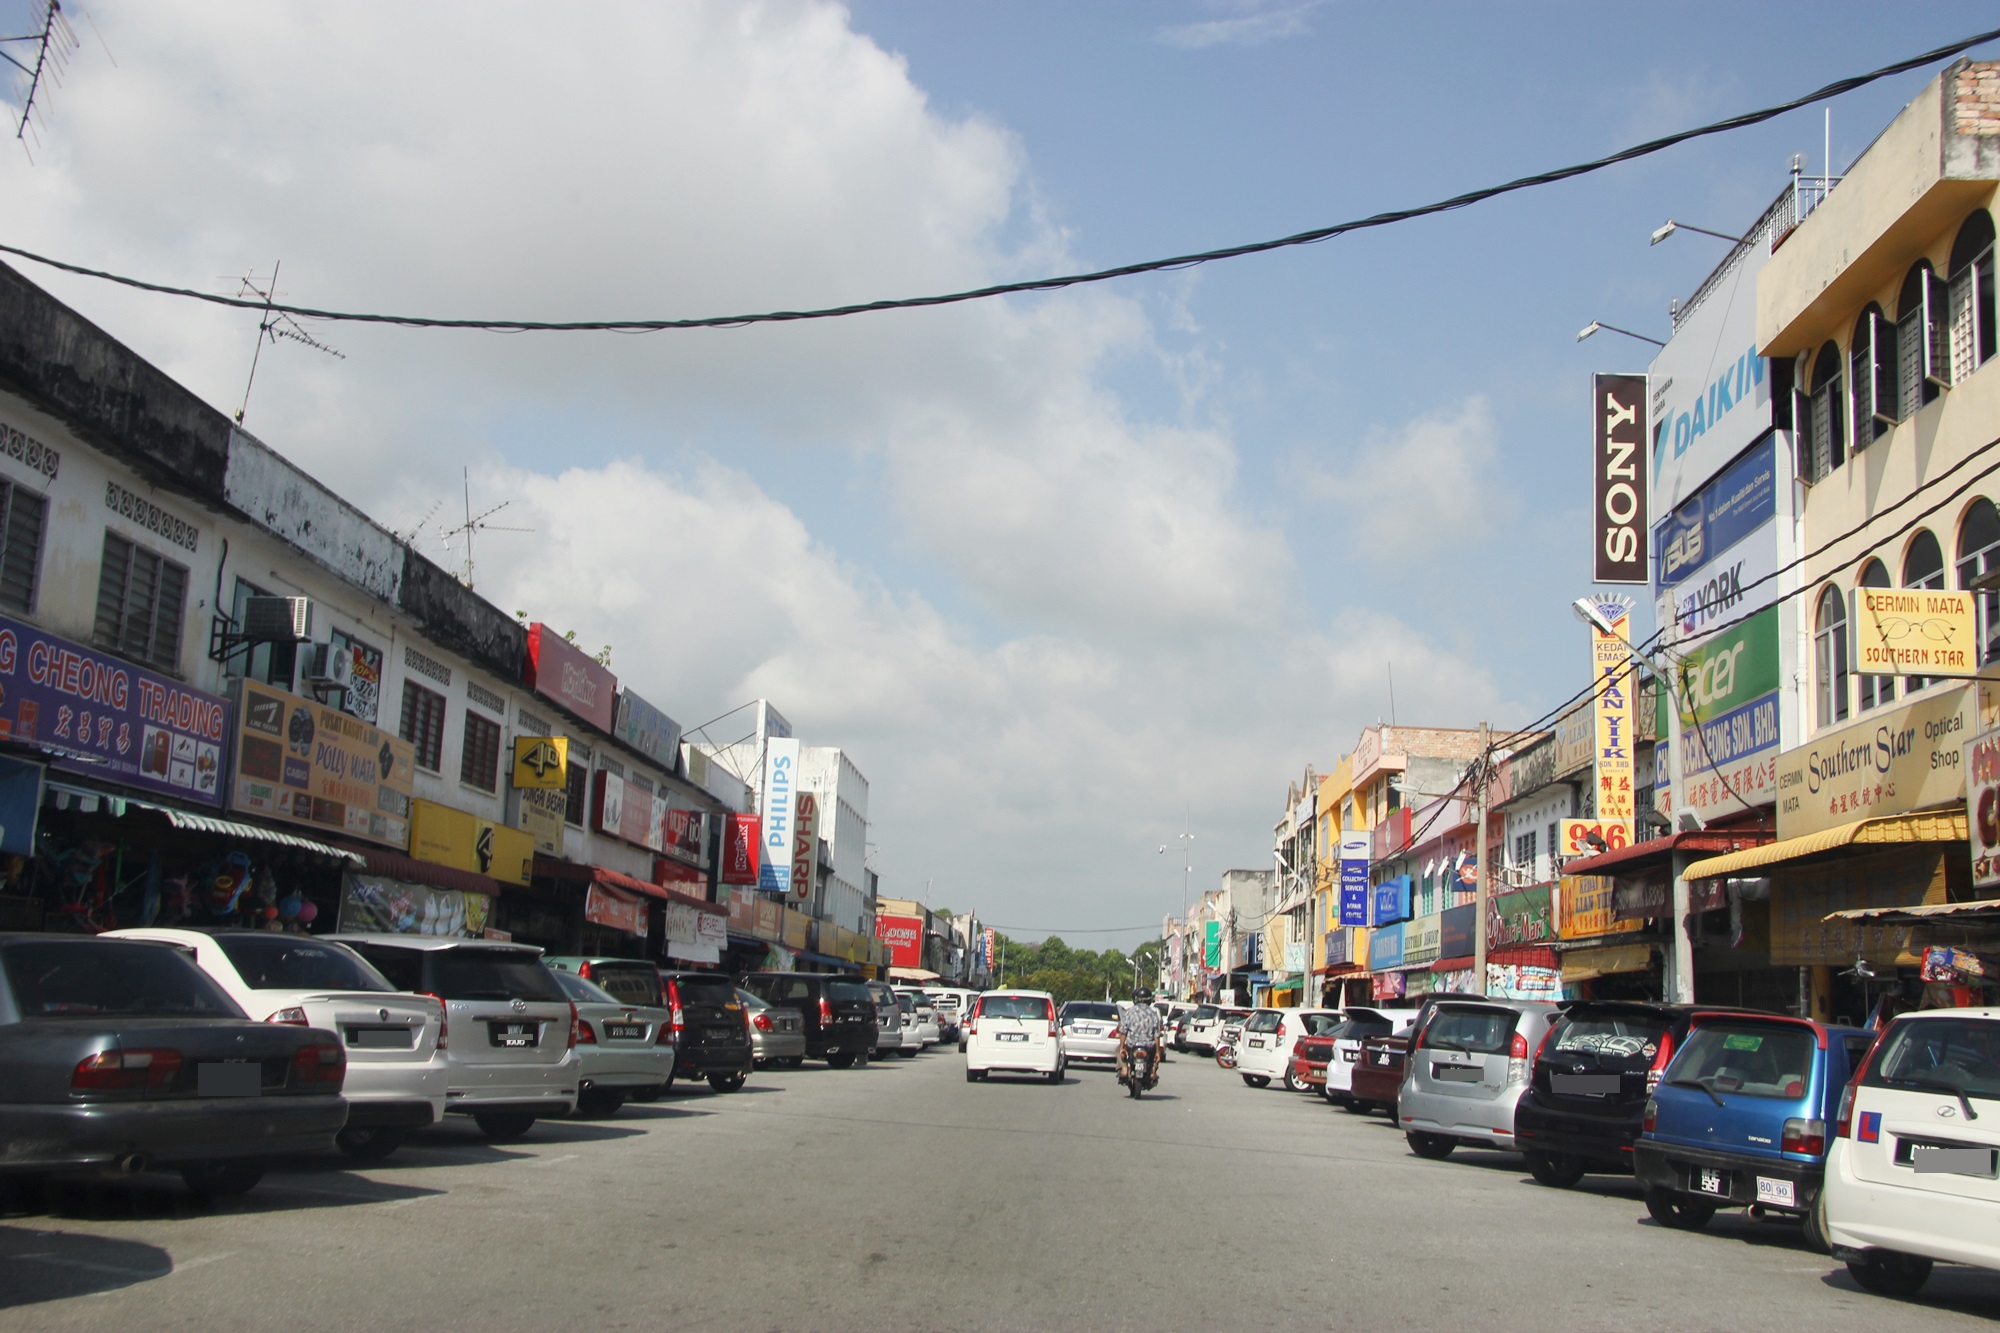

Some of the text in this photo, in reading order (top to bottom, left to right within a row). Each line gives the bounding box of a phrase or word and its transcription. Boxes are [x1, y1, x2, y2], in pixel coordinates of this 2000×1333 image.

[1674, 343, 1765, 460] DAIKIN
[1605, 392, 1638, 563] SONY
[1754, 469, 1771, 488] Servis
[1661, 521, 1702, 581] ASUS
[1697, 560, 1744, 626] YORK
[1866, 595, 1965, 615] CERMIN MATA
[1596, 643, 1627, 652] KEDAI
[1597, 653, 1626, 661] EMAS
[1866, 648, 1965, 667] SOUTHERN STAR
[28, 640, 129, 711] CHEONG
[138, 677, 223, 741] TRADING
[1602, 666, 1625, 709] LIAN
[1682, 640, 1744, 714] acer
[319, 709, 342, 733] PUSAT
[342, 718, 363, 741] KASUT
[1702, 720, 1731, 767] LEONG
[1732, 711, 1754, 756] SDN.
[1754, 701, 1777, 747] BHD.
[1924, 711, 1963, 742] Optical
[286, 766, 308, 781] CASIO
[315, 742, 349, 780] POLLY
[1808, 725, 1915, 794] Southern Star
[1930, 749, 1960, 770] Shop
[1779, 768, 1803, 790] CERMIN
[546, 792, 565, 816] BESAR
[768, 755, 791, 847] PHILIPS
[1782, 796, 1800, 815] MATA
[1829, 782, 1895, 815] 南星眼鏡中心
[793, 794, 815, 899] SHARP
[1575, 895, 1594, 913] LIAN
[1374, 934, 1398, 960] SAMSUNG
[1863, 1113, 1878, 1141] L
[1760, 1180, 1771, 1192] 80
[1775, 1186, 1788, 1196] 90
